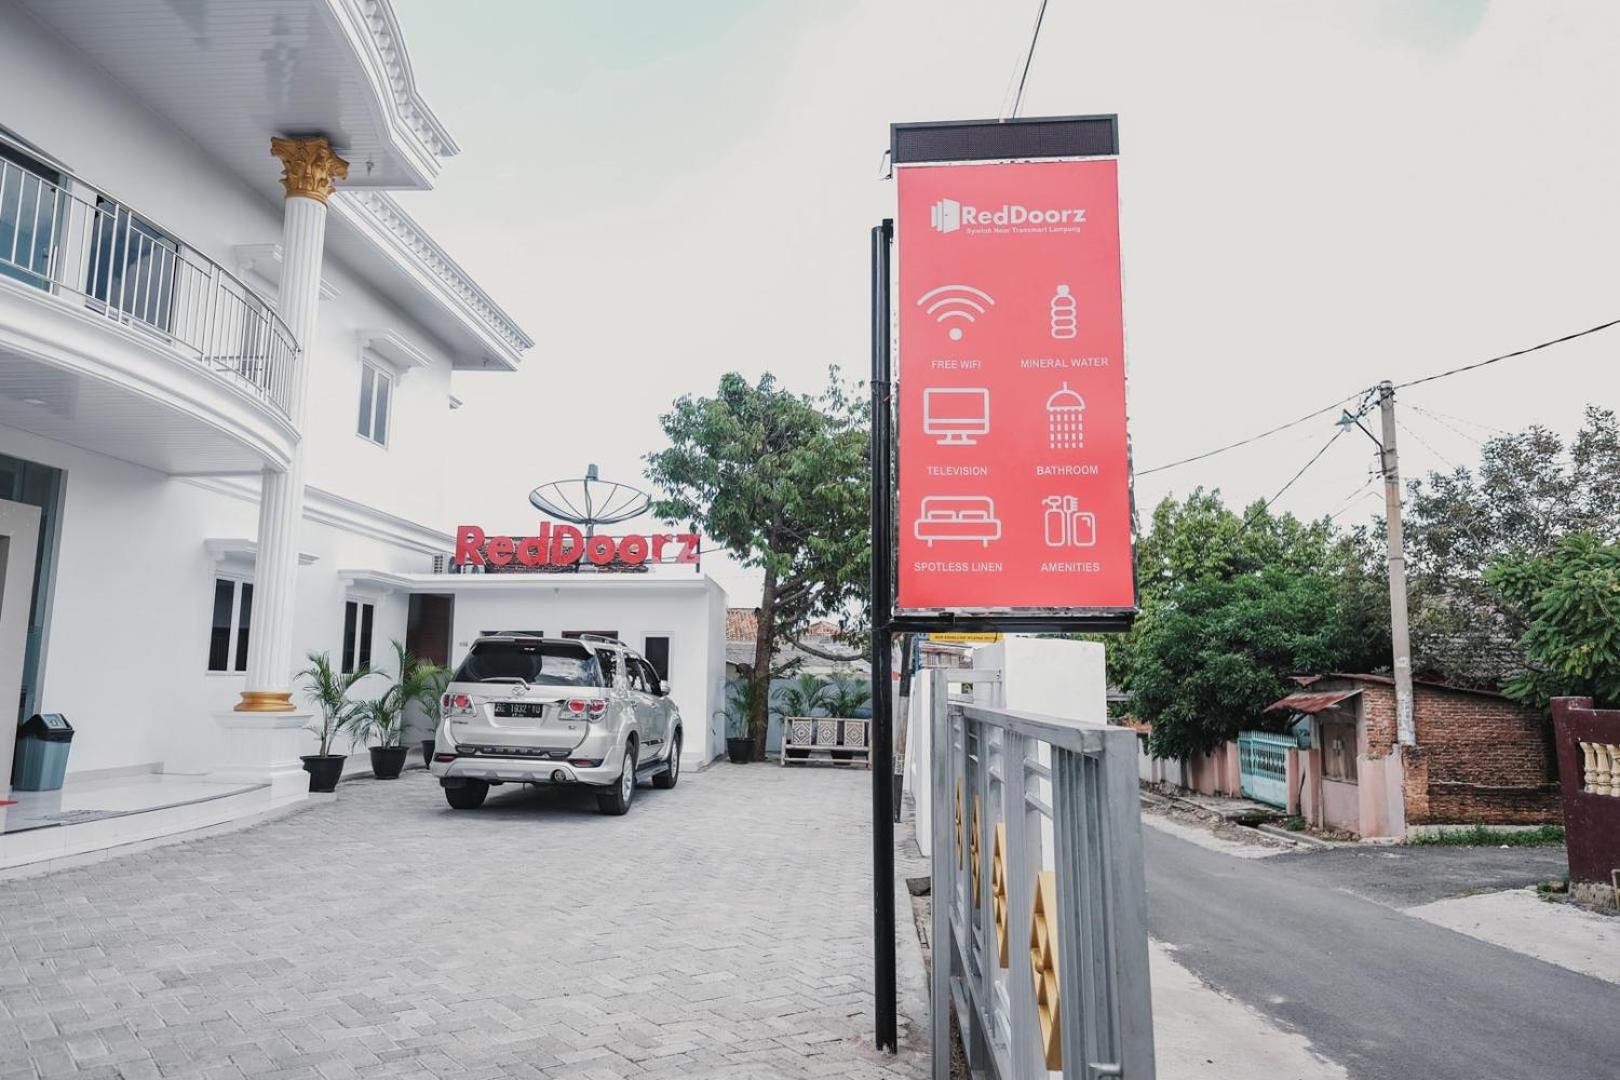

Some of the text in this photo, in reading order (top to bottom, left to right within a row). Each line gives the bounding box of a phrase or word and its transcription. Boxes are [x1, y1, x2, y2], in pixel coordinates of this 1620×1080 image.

[962, 205, 1087, 225] RedDoorz
[931, 359, 981, 369] FREE WIFI
[1020, 357, 1109, 369] MINERAL WATER
[927, 466, 988, 476] TELEVISION
[1036, 465, 1099, 476] BATHROOM
[455, 521, 701, 566] RedDoorz
[914, 562, 1003, 573] SPOTLESS LINEN
[1040, 562, 1101, 573] AMENITIES
